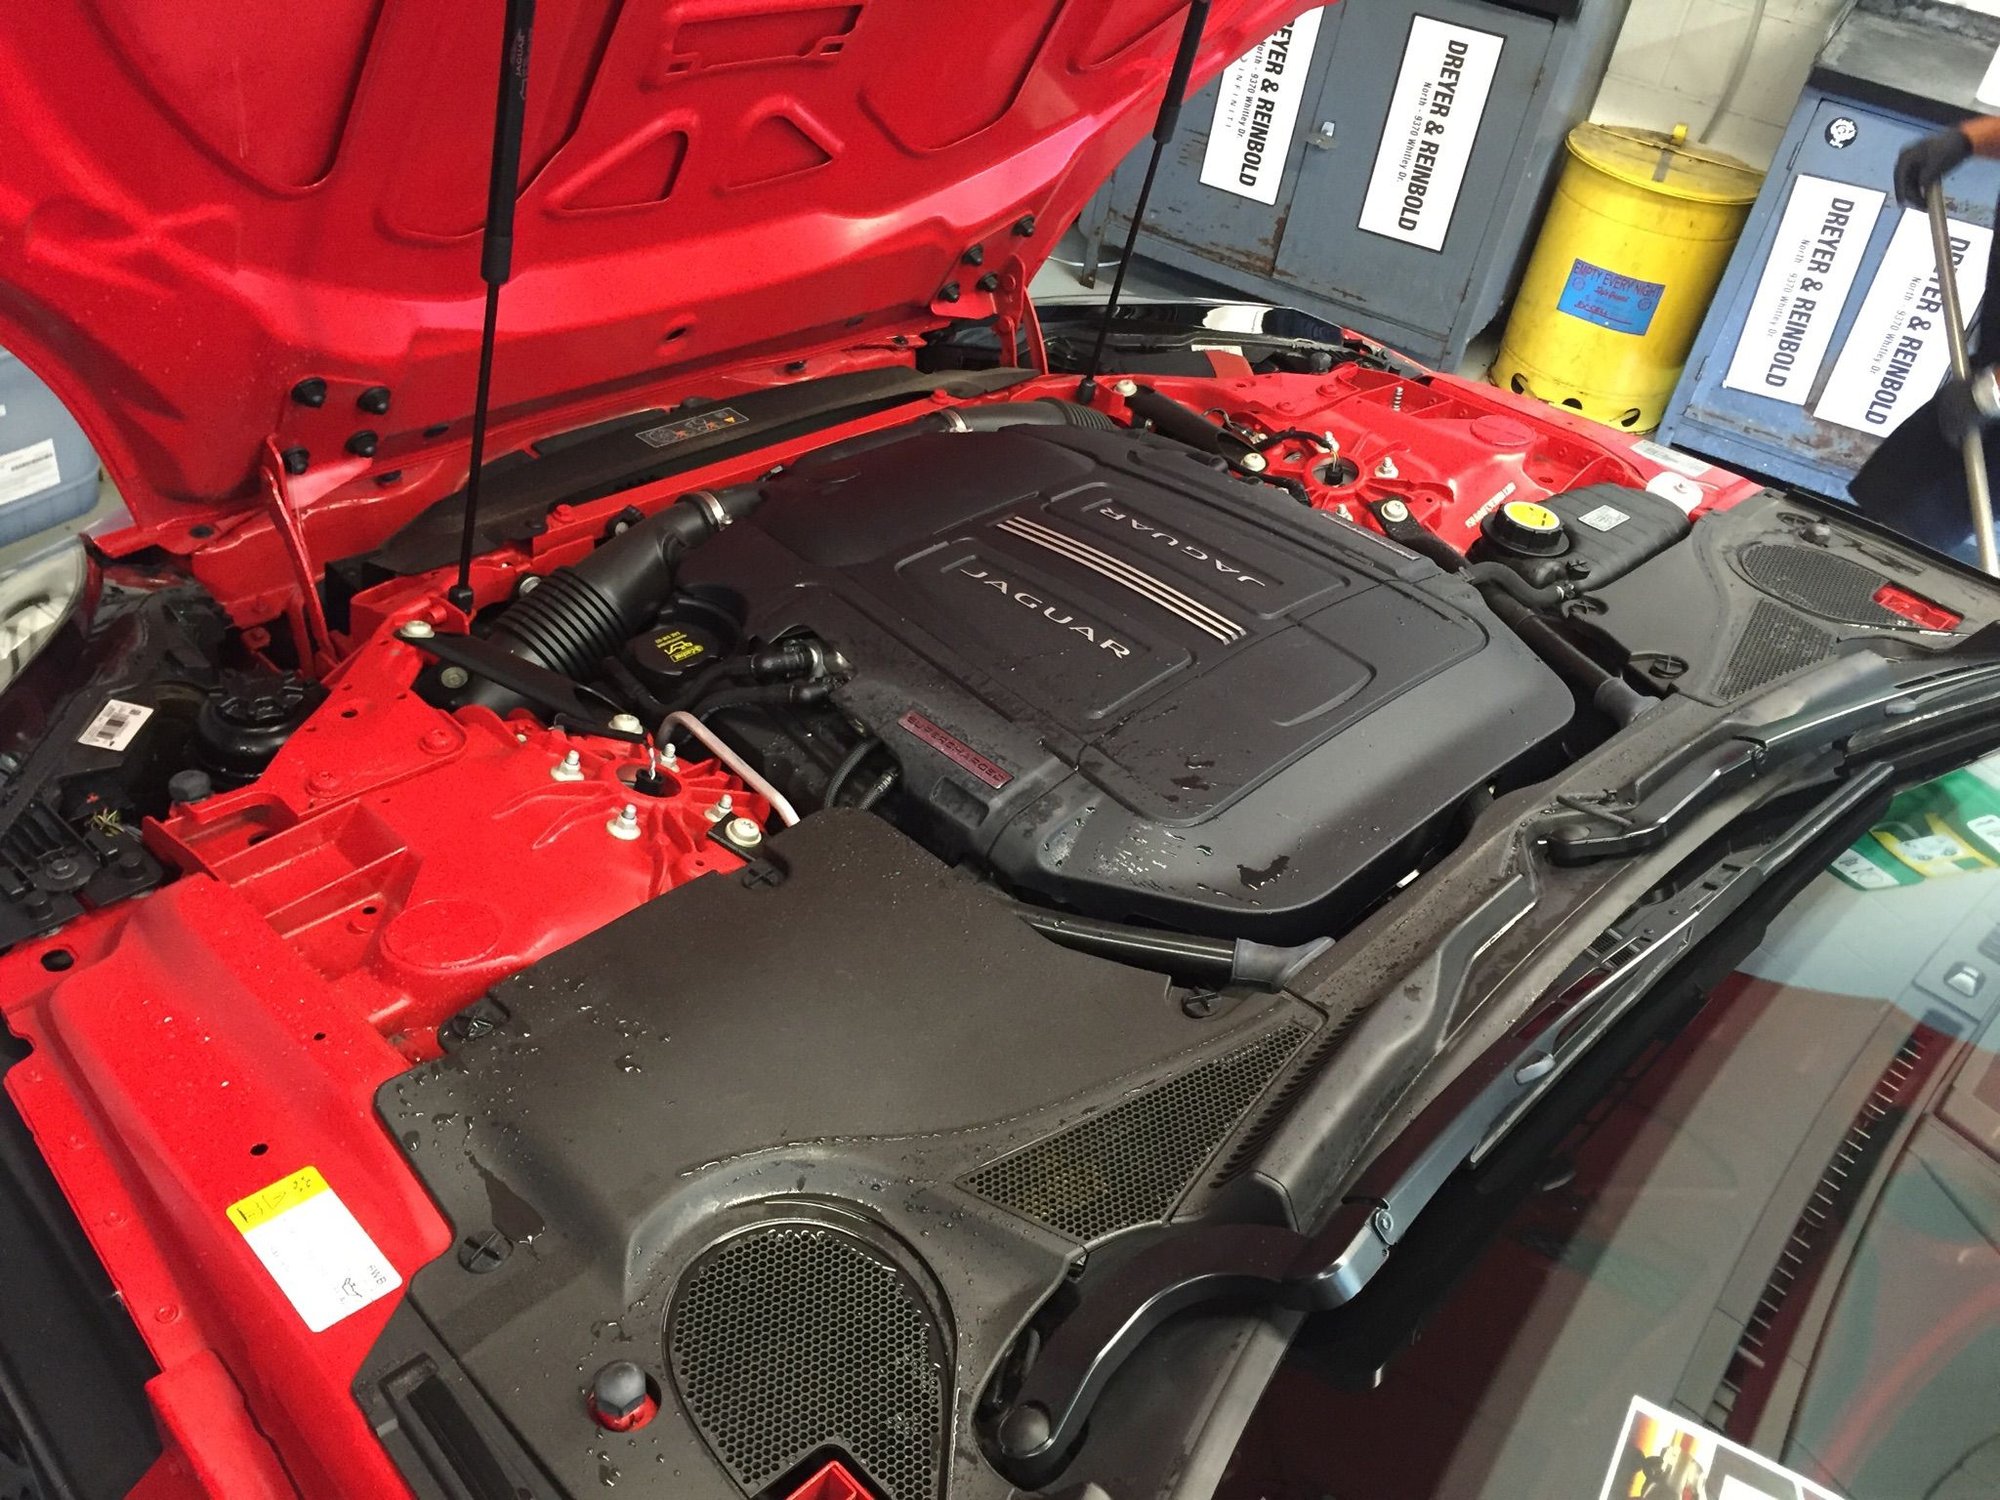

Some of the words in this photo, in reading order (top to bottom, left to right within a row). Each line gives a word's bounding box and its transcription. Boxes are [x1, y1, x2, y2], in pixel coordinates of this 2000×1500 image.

[1247, 73, 1259, 94] 9370
[1260, 78, 1279, 94] &
[1418, 82, 1432, 107] North
[1430, 40, 1469, 118] DREYER
[1226, 67, 1244, 129] INFINITI
[1238, 96, 1254, 127] Whitley
[1239, 97, 1275, 187] REINBOLD
[1409, 116, 1423, 137] 9370
[1424, 120, 1444, 136] &
[1400, 139, 1417, 170] Whitley
[1398, 140, 1439, 231] REINBOLD
[1794, 239, 1810, 264] North
[1807, 197, 1855, 275] DREYER
[1573, 261, 1604, 282] EMPTY
[1603, 273, 1634, 292] EVERY
[1635, 281, 1663, 299] NIGHT
[1783, 273, 1798, 294] 9370
[1800, 277, 1823, 292] &
[1904, 276, 1922, 302] North
[1770, 296, 1789, 328] Whitley
[1891, 310, 1906, 332] 9370
[1907, 316, 1932, 332] &
[1765, 297, 1817, 387] REINBOLD
[1875, 333, 1896, 364] Whitley
[1865, 336, 1923, 425] REINBOLD
[1099, 507, 1266, 588] JAGUAR
[961, 568, 1131, 660] JAGUAR
[906, 715, 1007, 782] SUPERCHARGED
